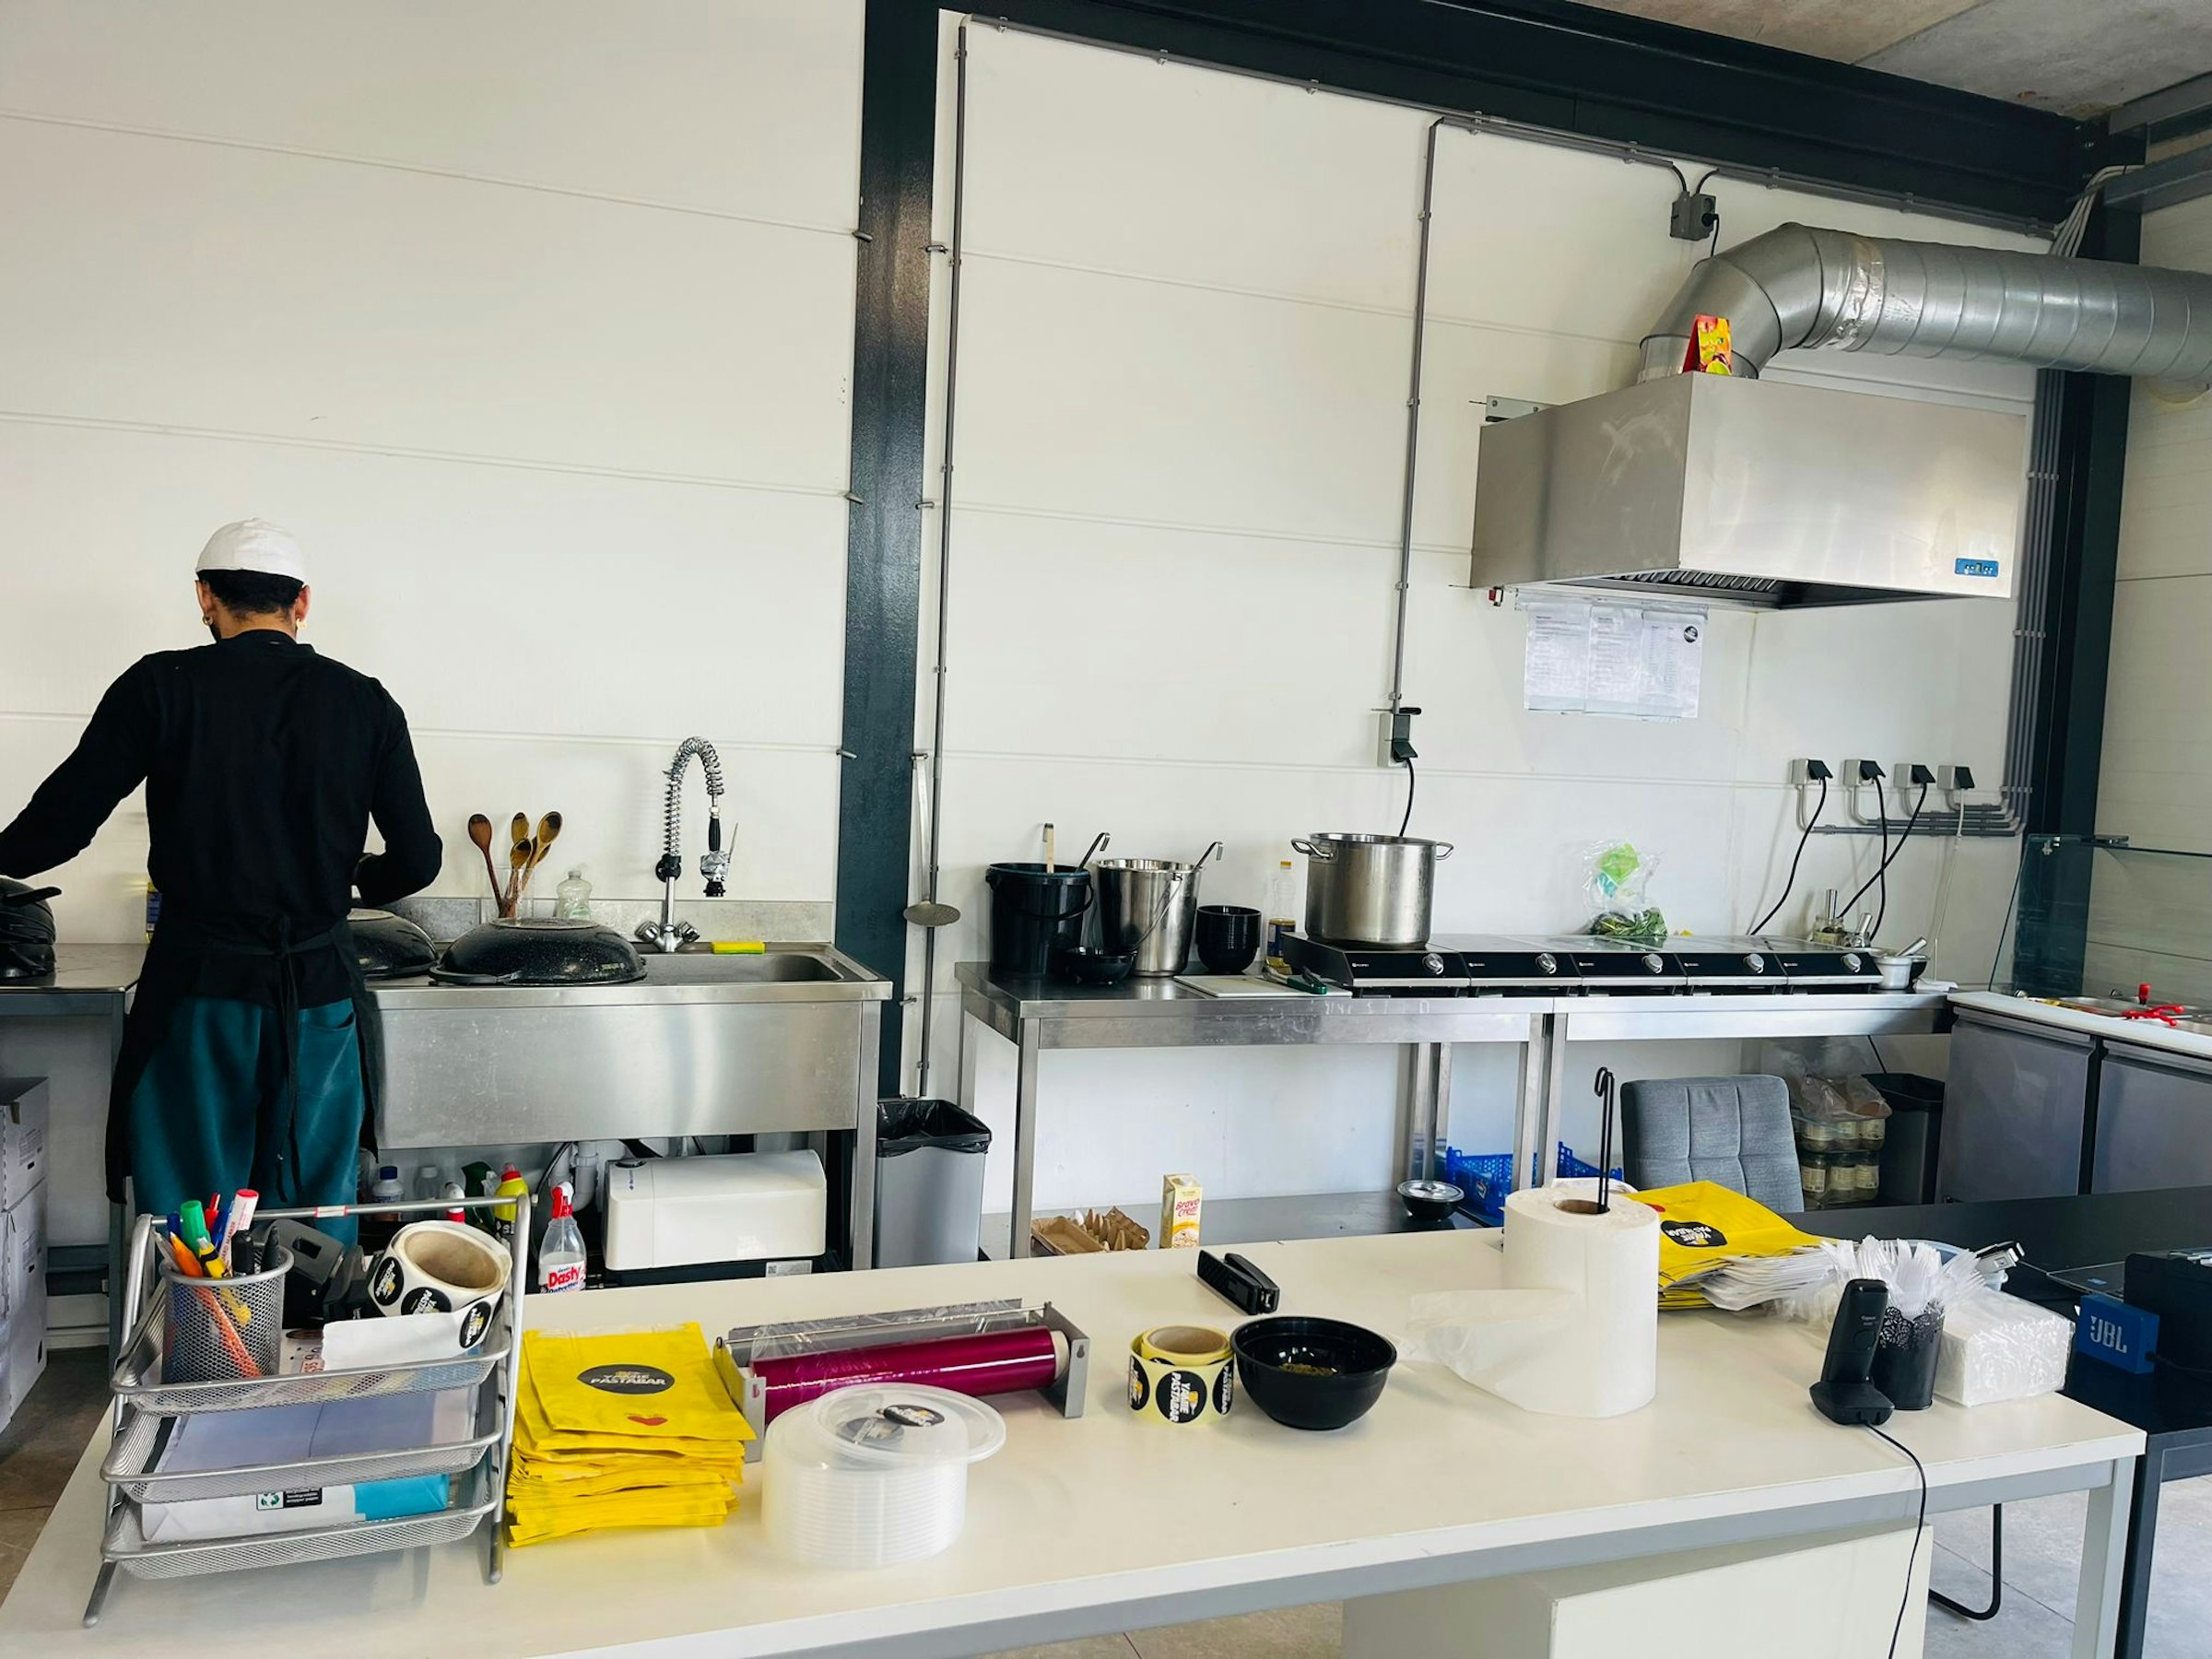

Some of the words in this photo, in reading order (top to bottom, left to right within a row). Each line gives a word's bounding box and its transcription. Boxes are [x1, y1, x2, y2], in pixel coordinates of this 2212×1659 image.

[2090, 1319, 2127, 1353] JBL
[1170, 1372, 1181, 1422] PASTABAR
[1180, 1382, 1190, 1414] YAMIE
